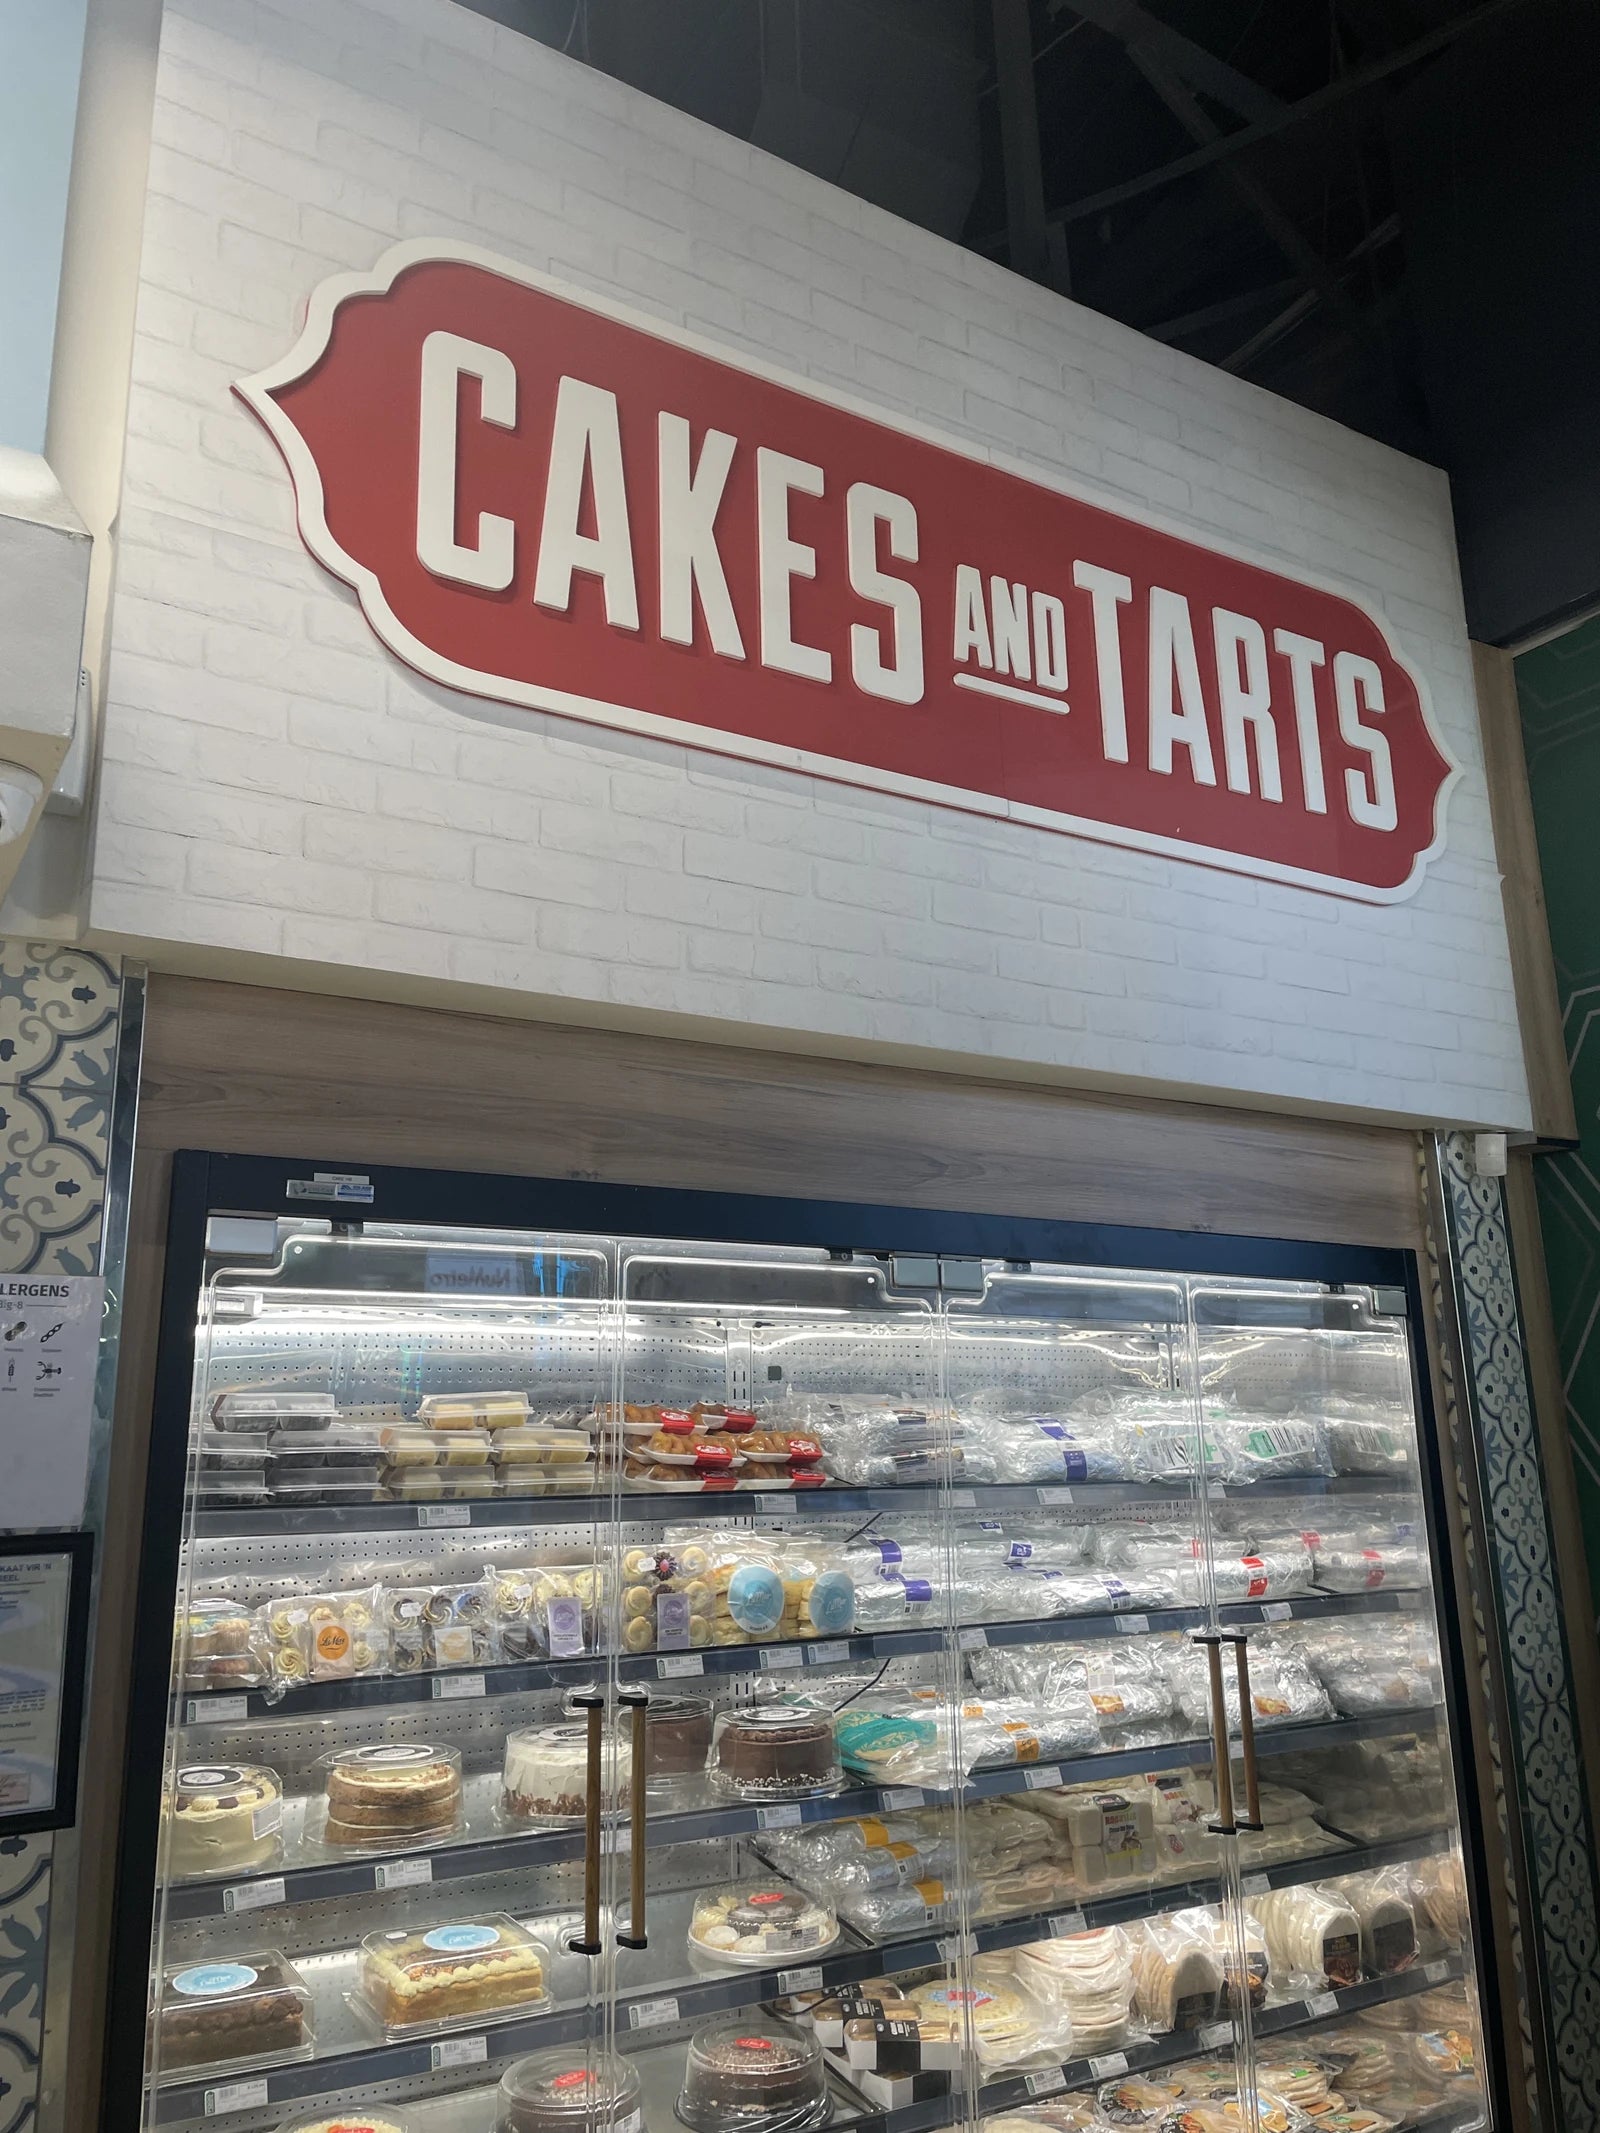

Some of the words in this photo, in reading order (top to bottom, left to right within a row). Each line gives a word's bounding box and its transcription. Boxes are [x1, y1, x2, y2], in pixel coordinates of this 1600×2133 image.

[416, 330, 924, 705] CAKES
[953, 563, 1069, 692] AND
[1073, 559, 1398, 832] TARTS
